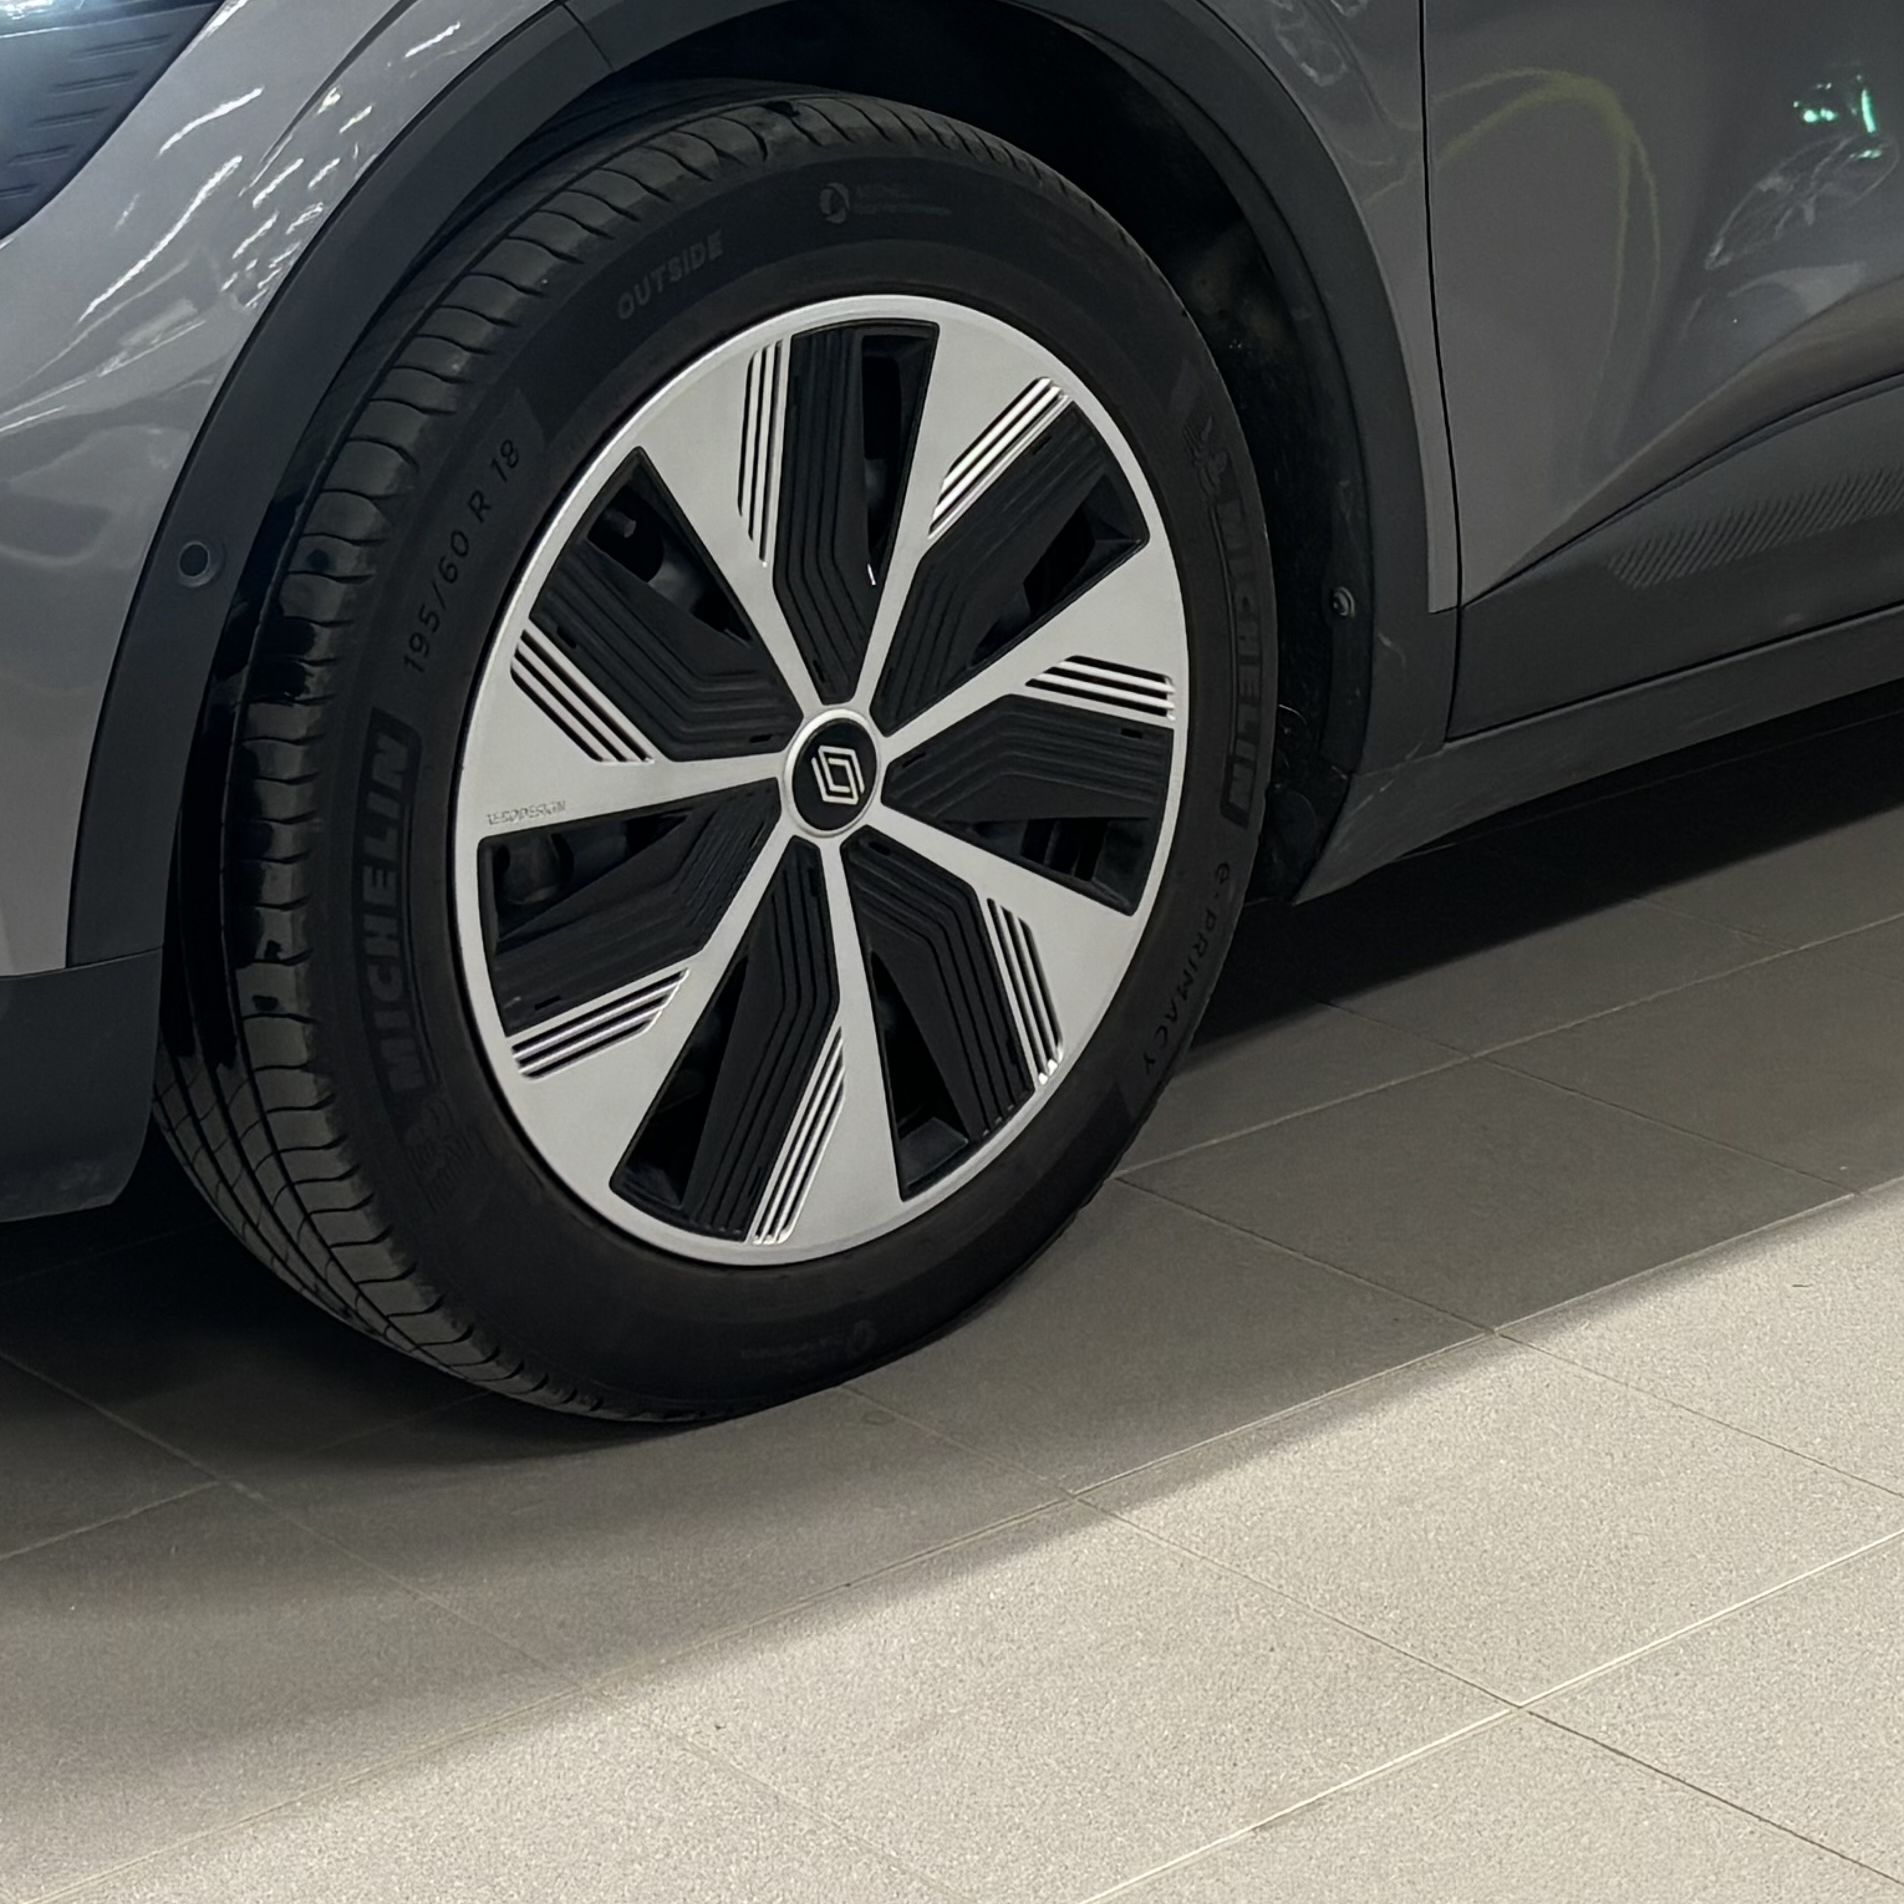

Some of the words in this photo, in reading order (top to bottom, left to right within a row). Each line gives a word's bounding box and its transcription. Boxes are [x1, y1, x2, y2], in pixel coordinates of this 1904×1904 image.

[616, 228, 725, 321] OUTSIDE
[401, 528, 471, 675] 195/60
[466, 489, 493, 524] R
[489, 438, 520, 484] 18
[361, 733, 431, 1095] MICHELIN
